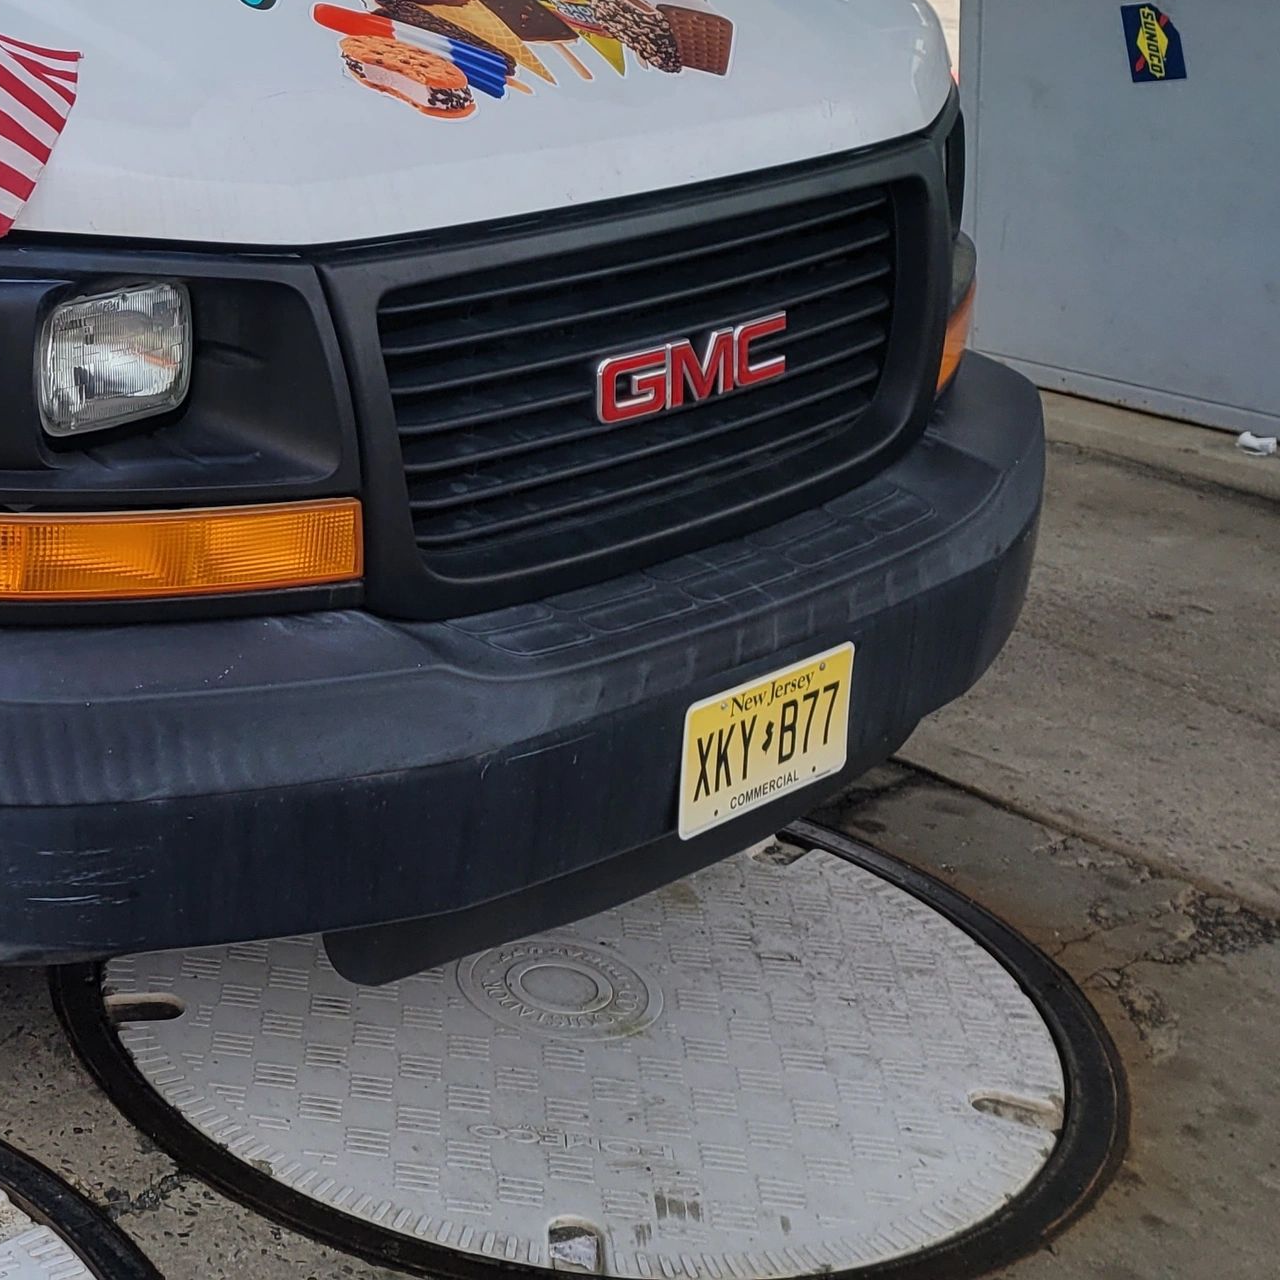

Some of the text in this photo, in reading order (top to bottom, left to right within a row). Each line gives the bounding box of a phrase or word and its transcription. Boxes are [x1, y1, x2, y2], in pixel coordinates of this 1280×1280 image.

[1140, 9, 1164, 74] SUNOCO
[597, 310, 787, 424] GMC
[730, 671, 815, 718] New Jersey
[693, 680, 840, 803] XKY B77
[730, 771, 799, 809] COMMERCIAL
